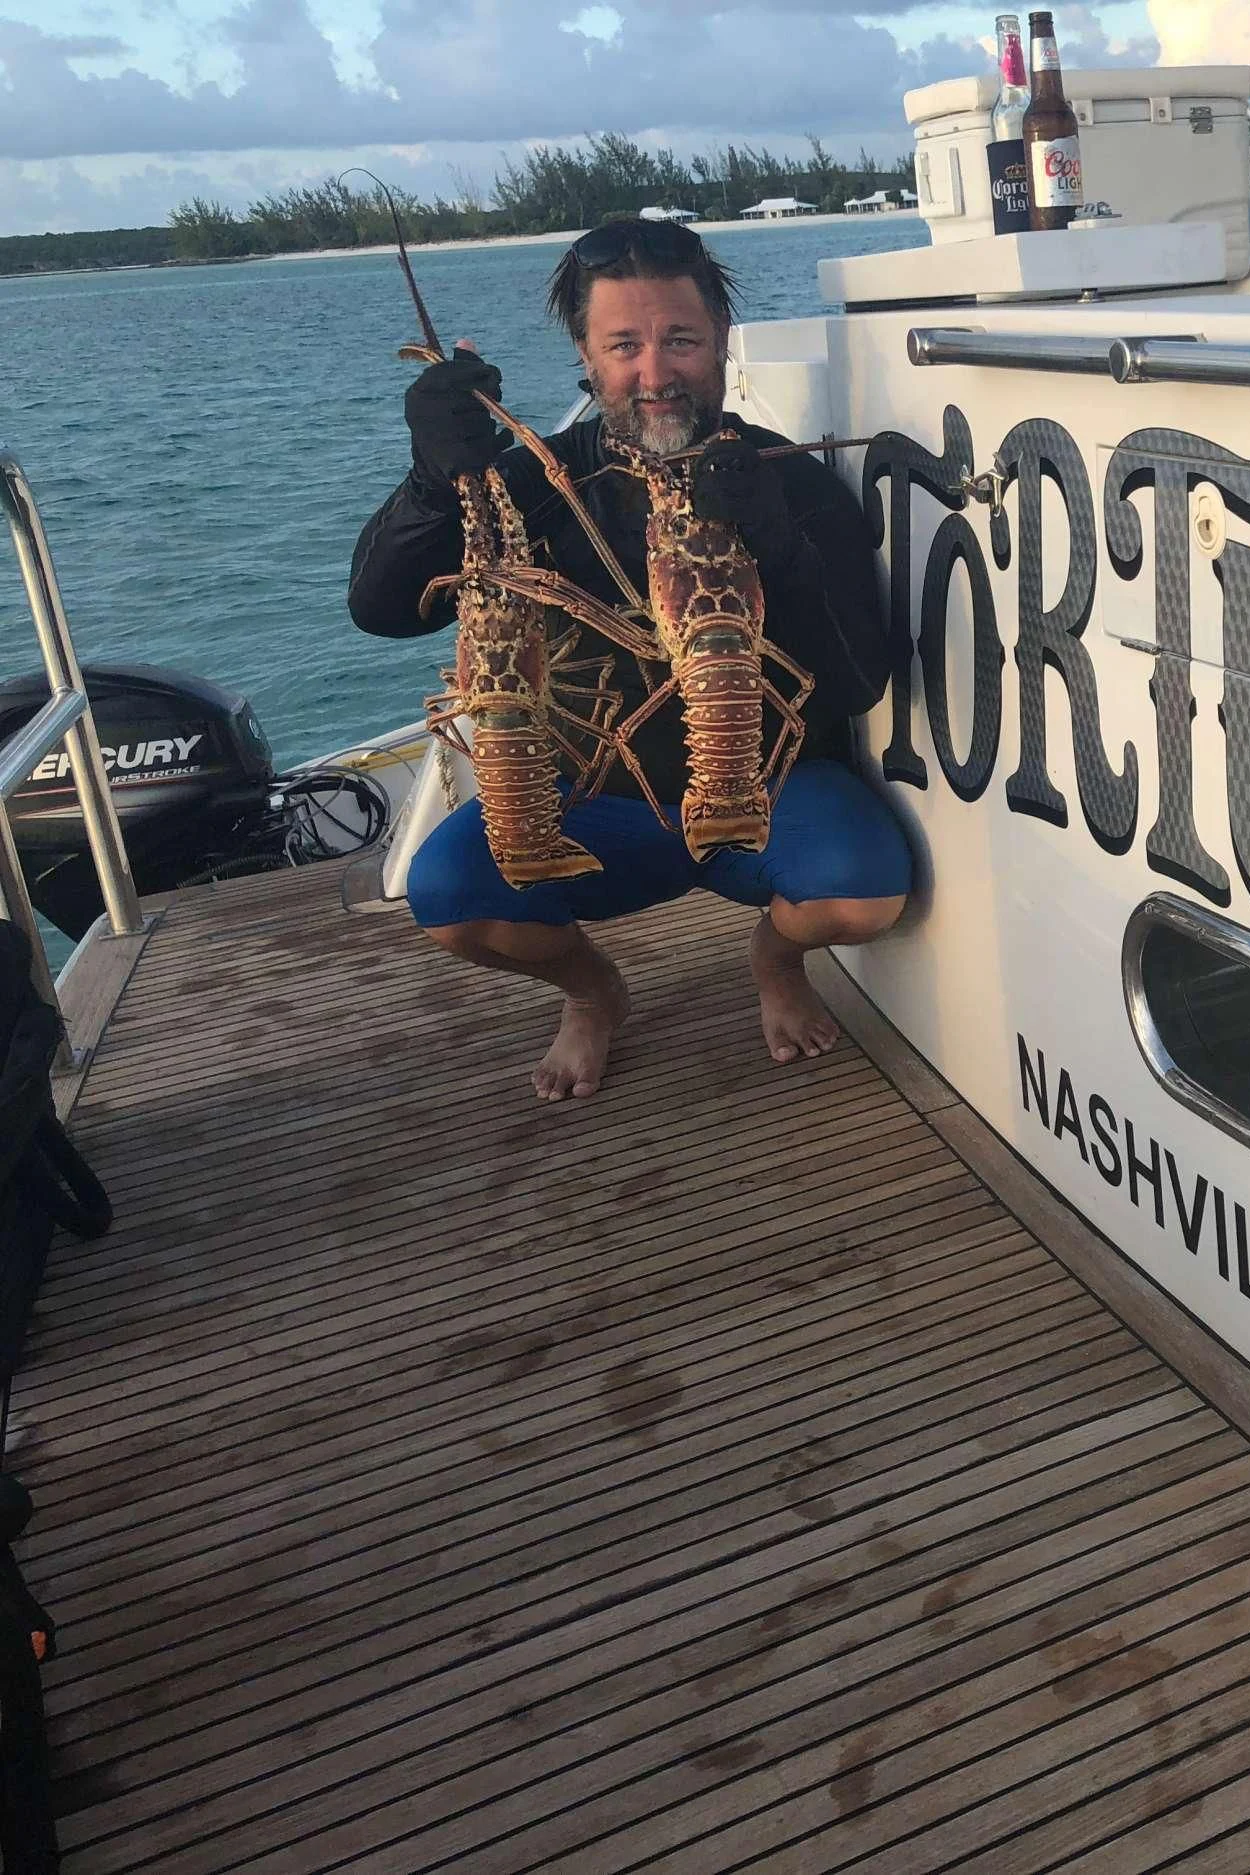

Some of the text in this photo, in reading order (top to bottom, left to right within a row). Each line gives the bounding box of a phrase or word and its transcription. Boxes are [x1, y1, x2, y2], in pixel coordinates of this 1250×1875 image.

[1044, 150, 1080, 177] Coo
[992, 179, 1028, 200] Coro
[1057, 177, 1081, 190] LIGH
[1005, 195, 1030, 213] Lig
[27, 734, 203, 781] ERCURY
